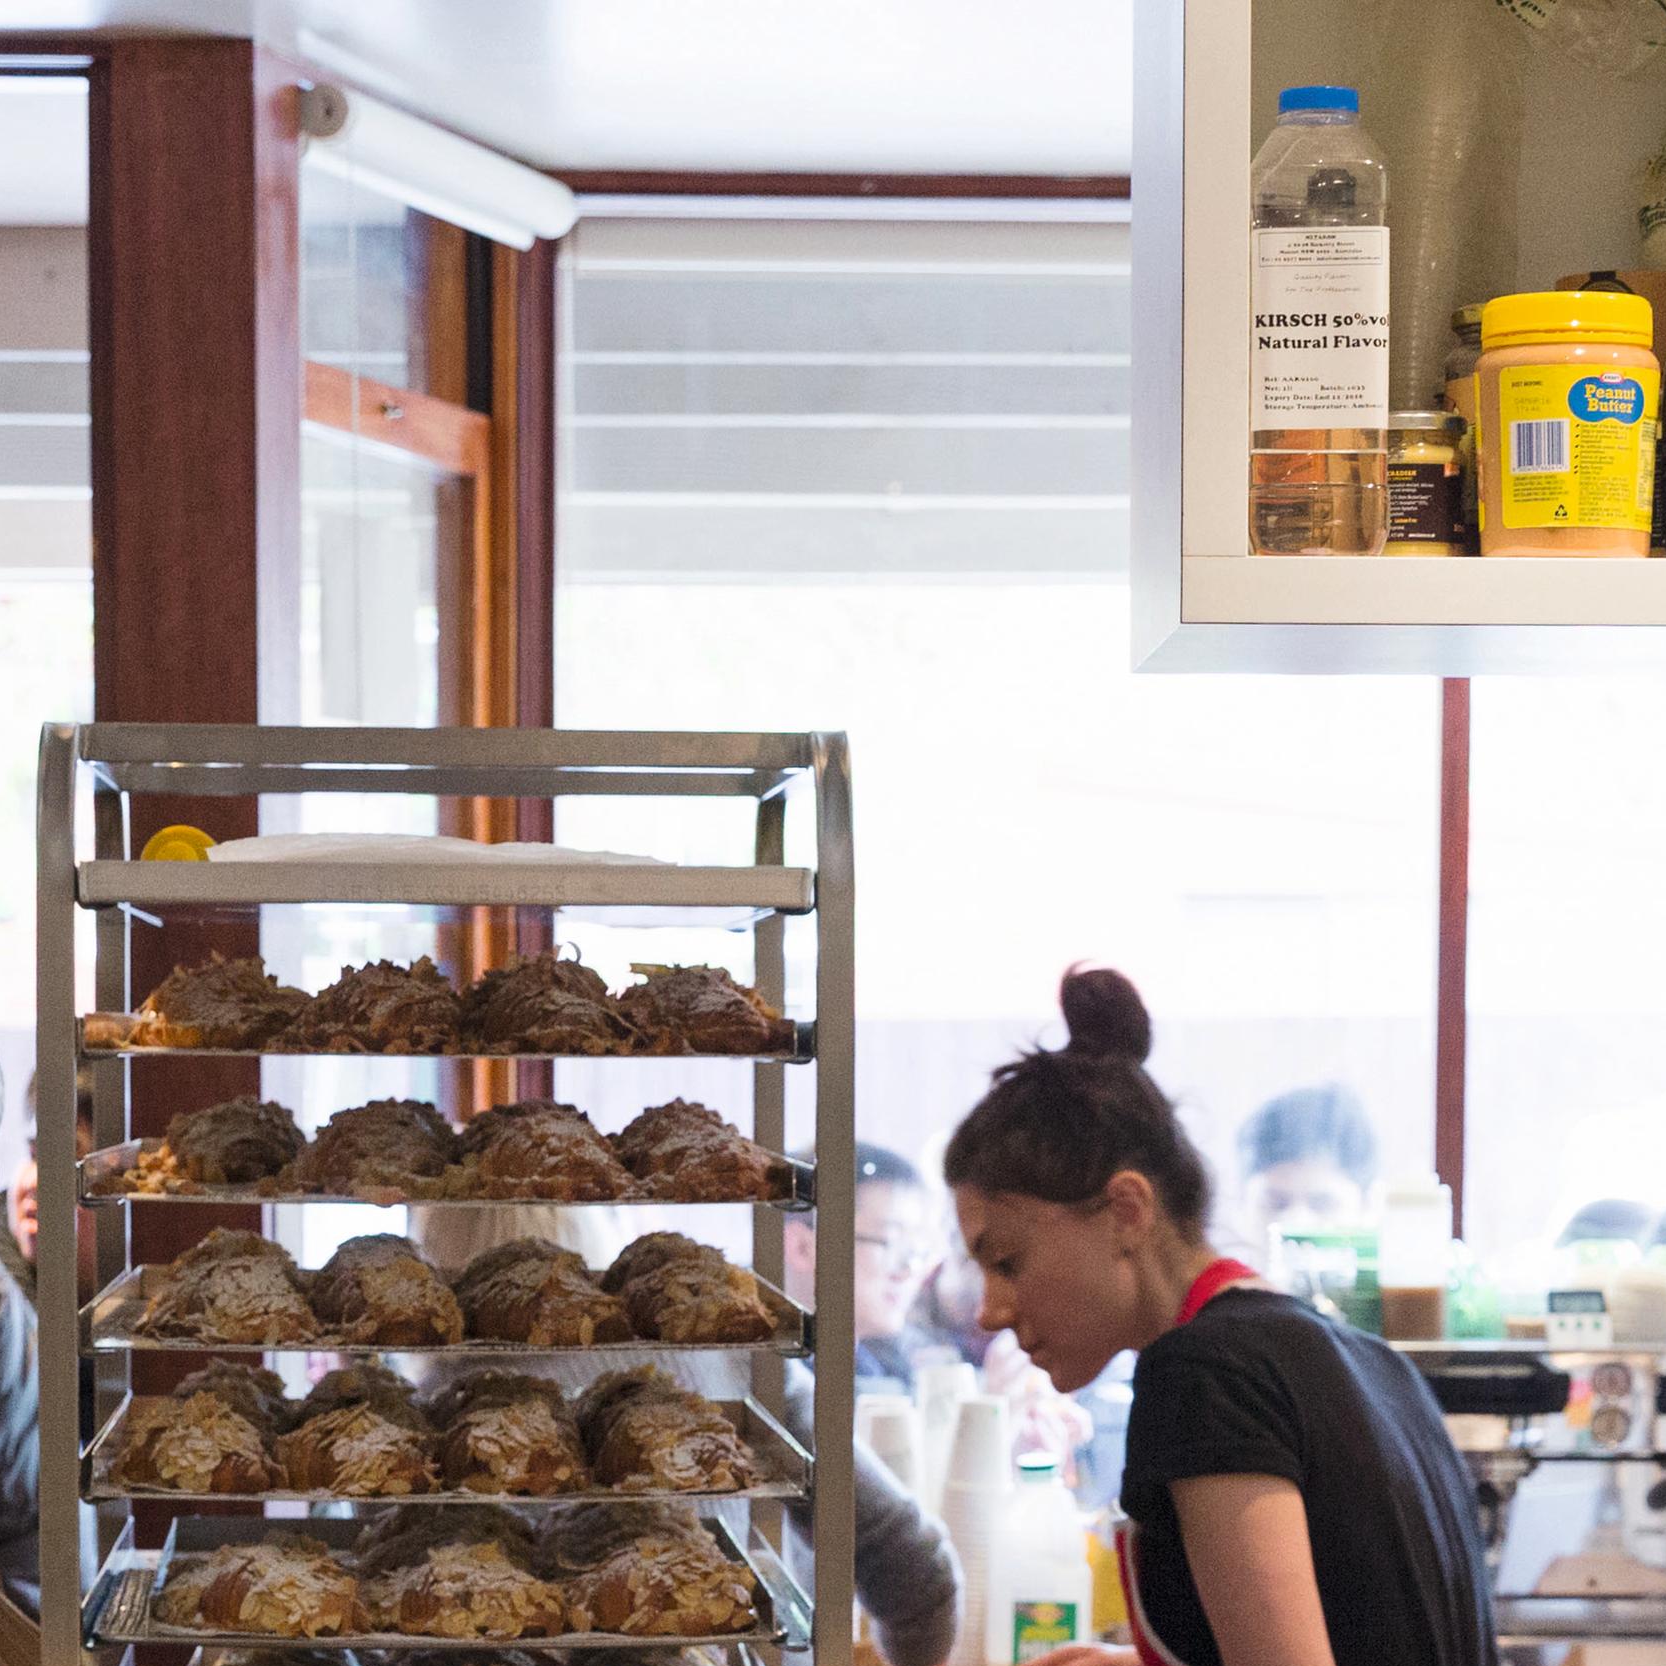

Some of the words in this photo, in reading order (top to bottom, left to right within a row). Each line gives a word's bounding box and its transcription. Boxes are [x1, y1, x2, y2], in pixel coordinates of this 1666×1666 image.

[1255, 314, 1327, 328] KIRSCH
[1258, 336, 1328, 349] Natural
[1333, 335, 1388, 348] Flavor
[1585, 383, 1636, 400] Peanut
[1588, 399, 1633, 414] Butter
